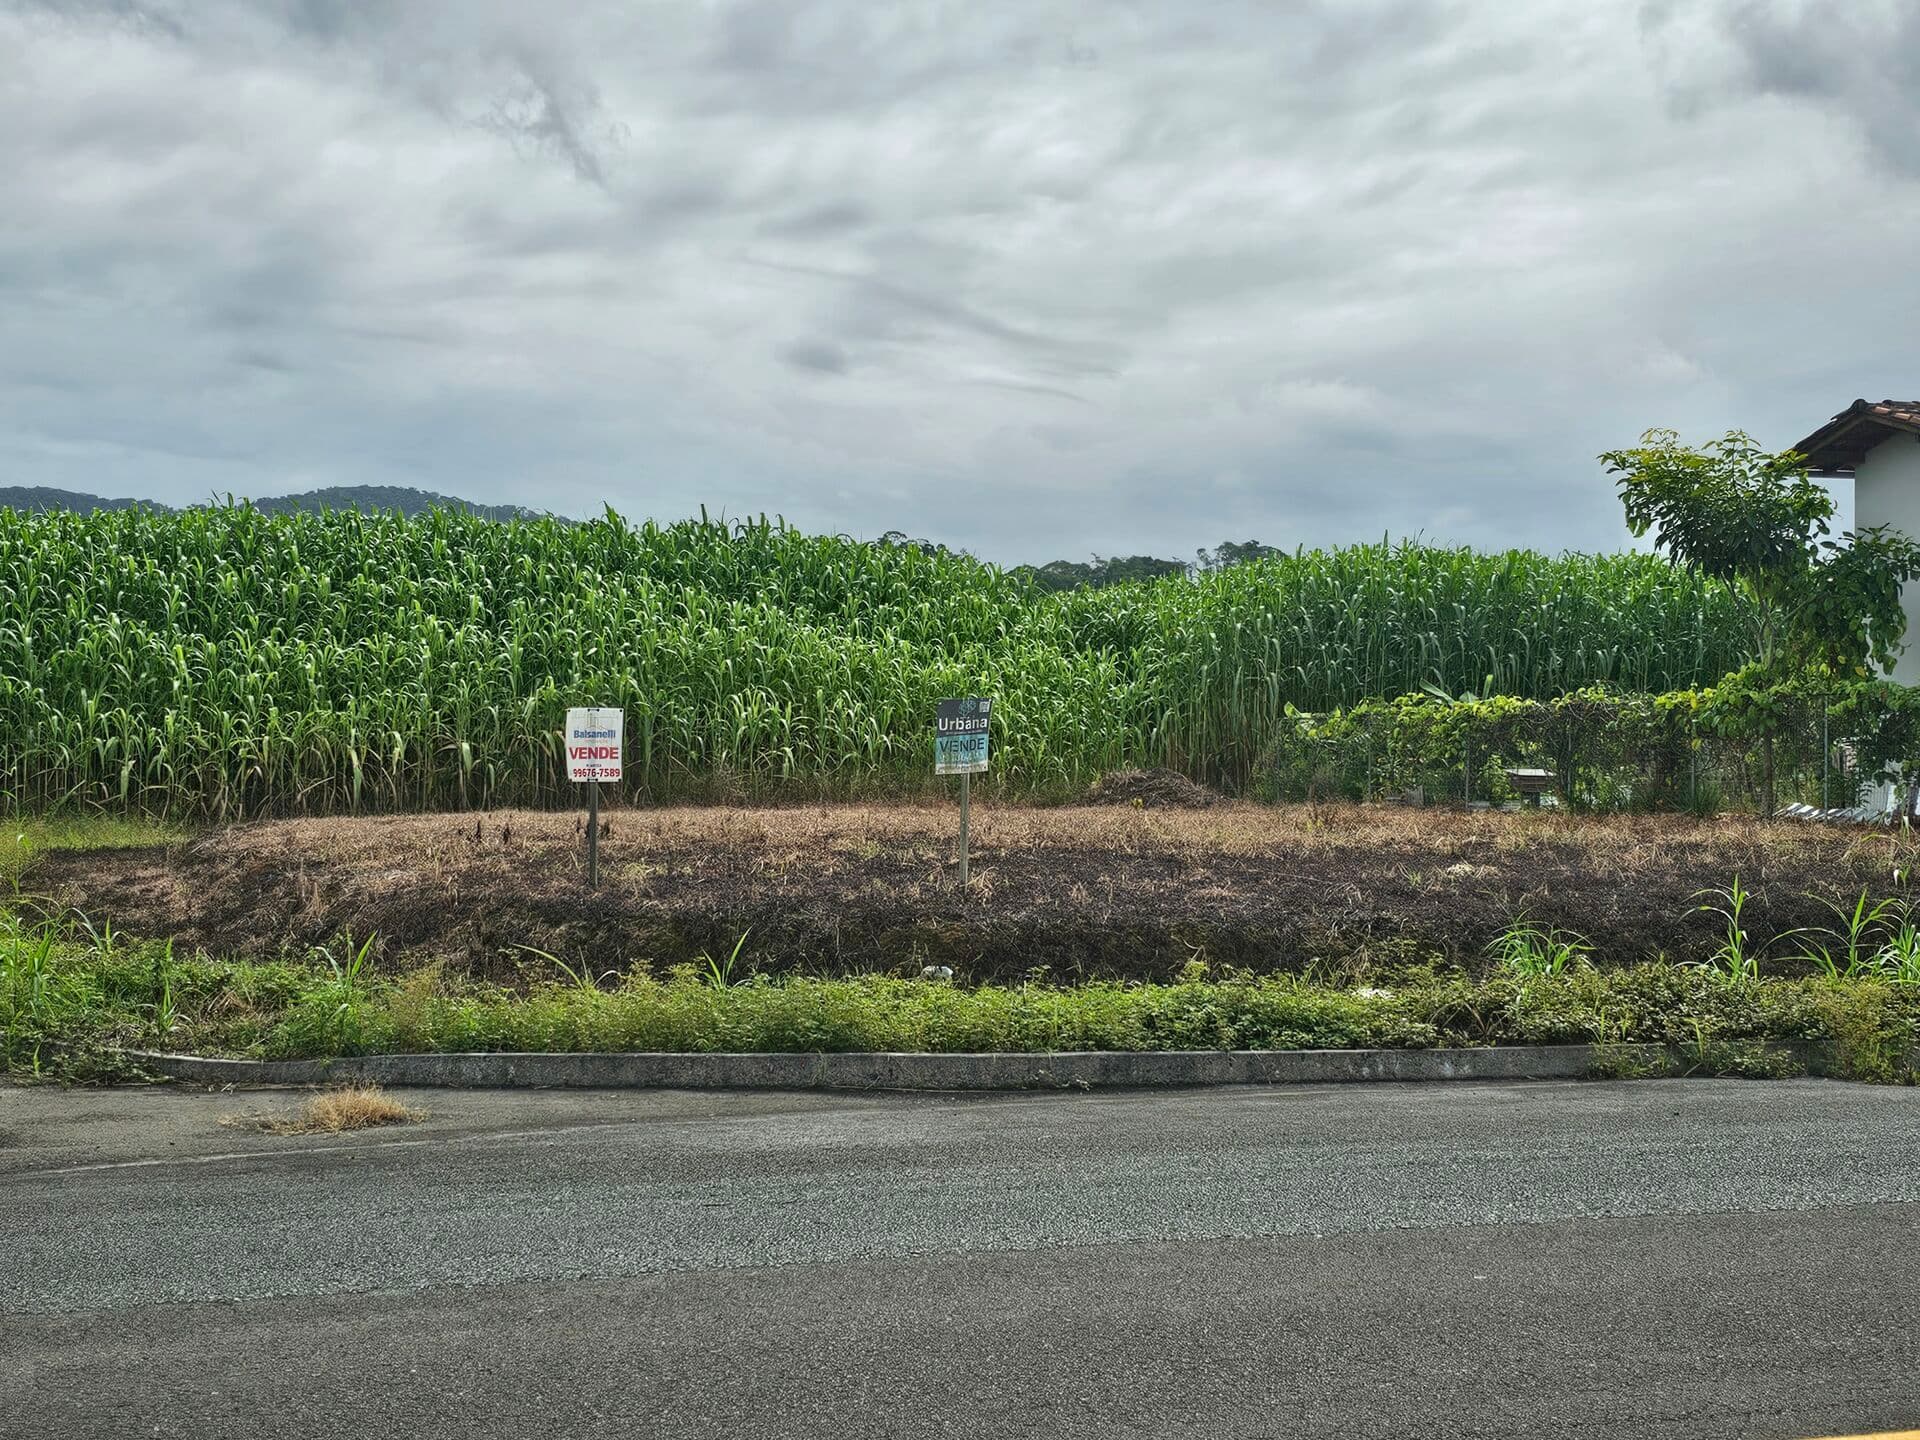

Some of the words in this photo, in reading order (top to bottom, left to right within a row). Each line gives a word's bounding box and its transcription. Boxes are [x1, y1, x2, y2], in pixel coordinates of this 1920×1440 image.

[574, 730, 616, 738] Balsanelli
[940, 738, 984, 752] VENDE
[569, 747, 618, 760] VENDE
[573, 768, 620, 777] 99676-7589
